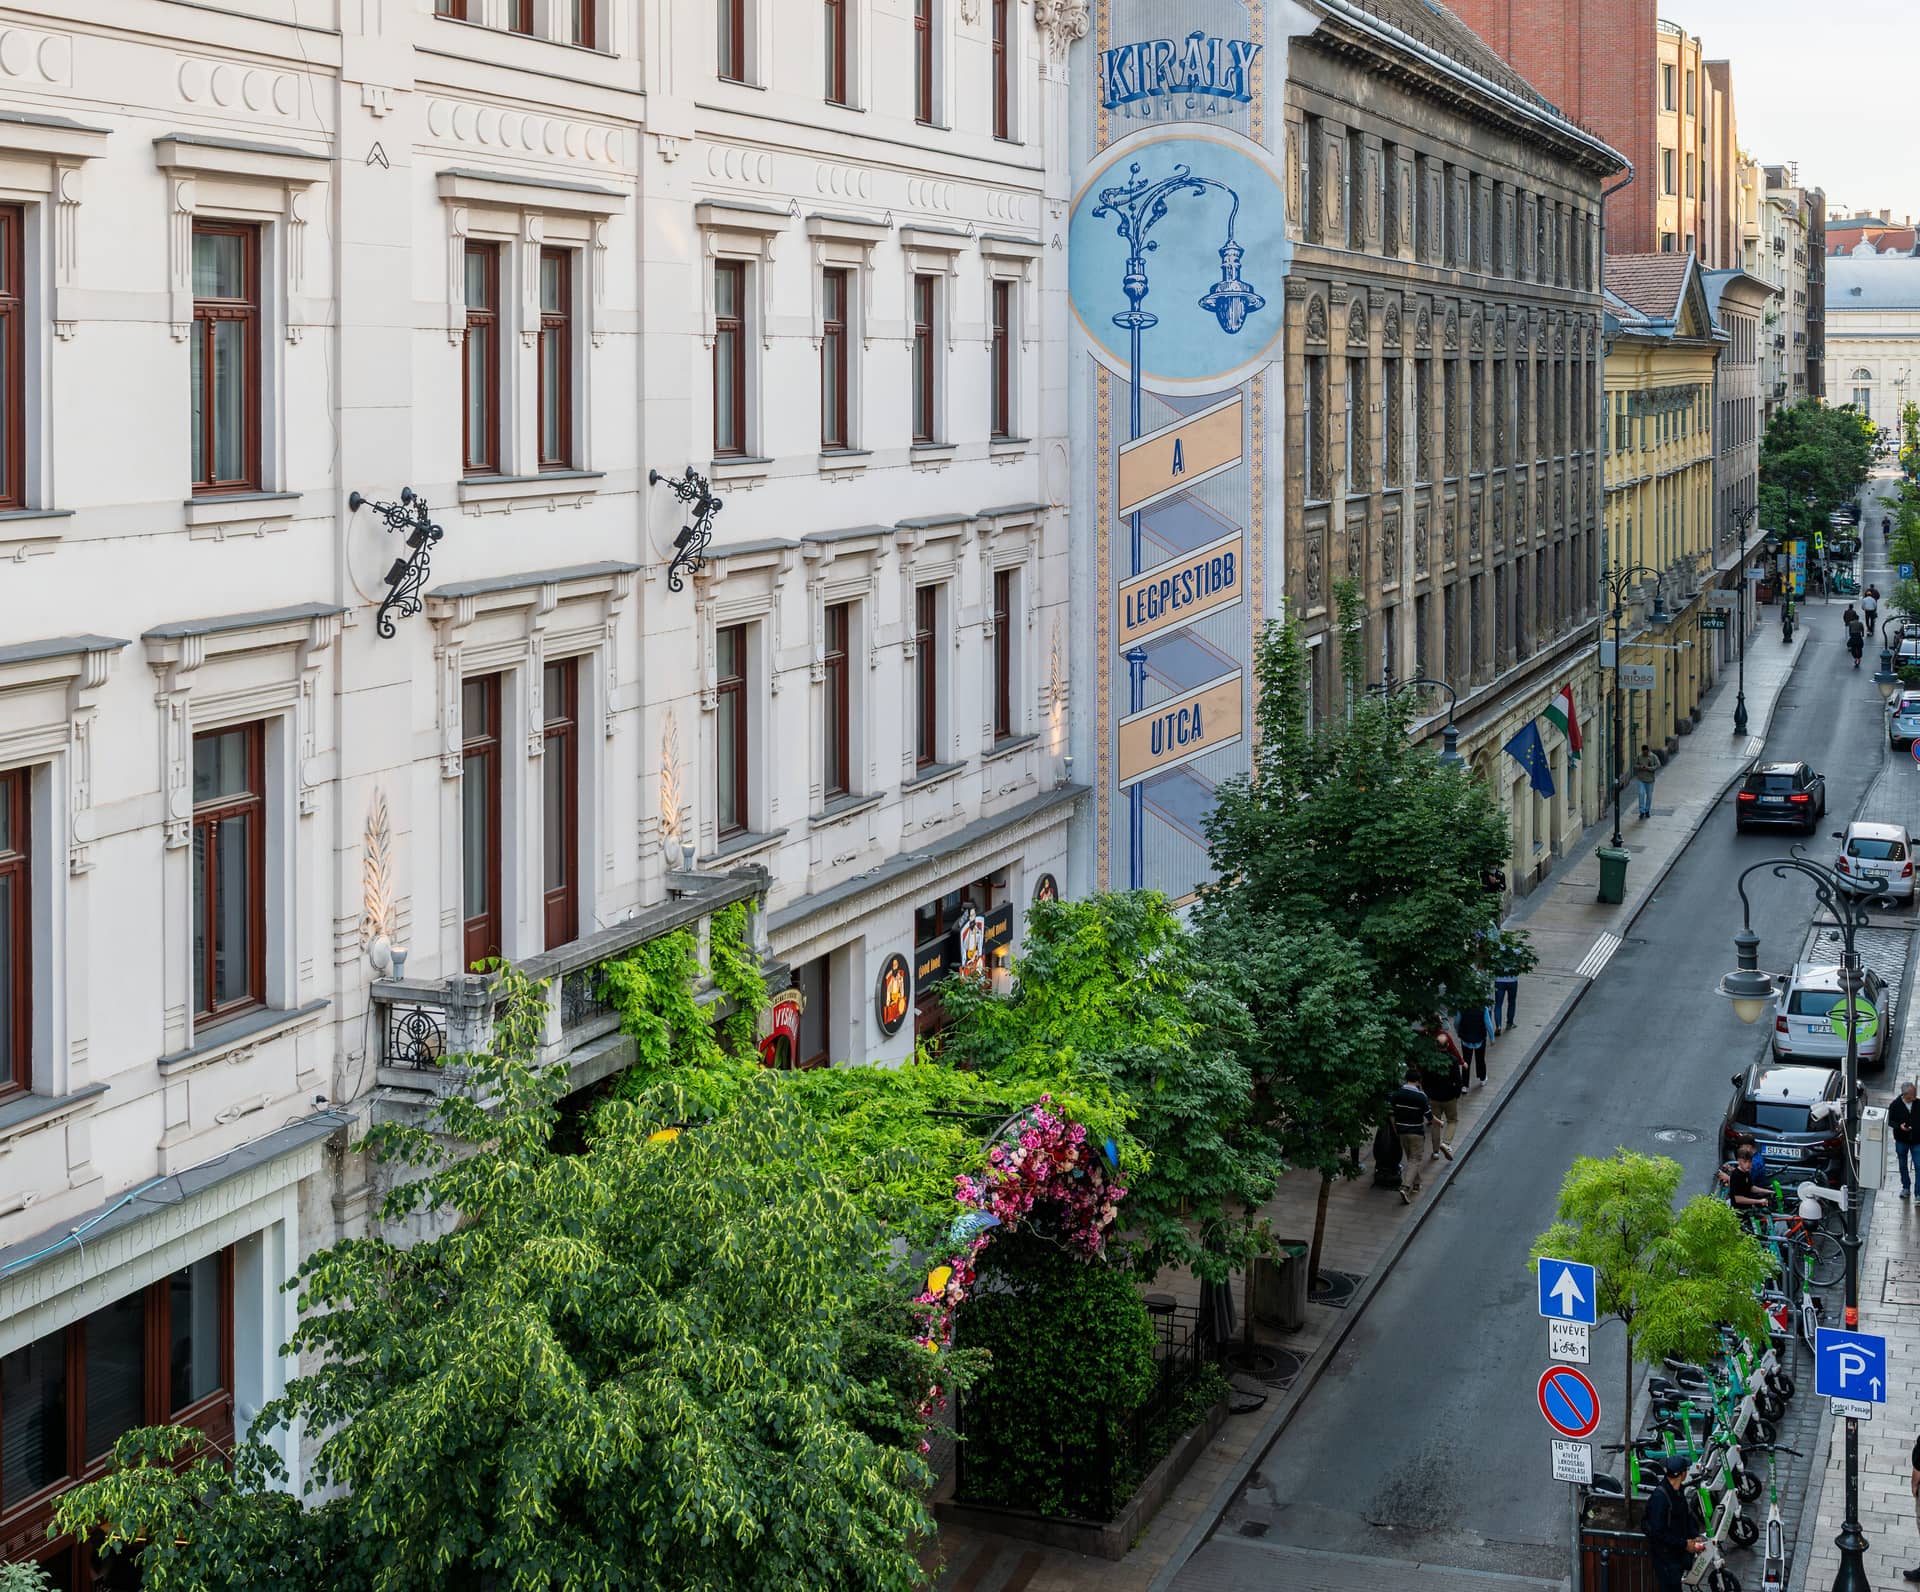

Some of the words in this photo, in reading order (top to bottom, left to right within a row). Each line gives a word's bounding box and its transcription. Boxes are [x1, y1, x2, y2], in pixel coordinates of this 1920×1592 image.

[1100, 31, 1263, 110] KIRÁLY
[1142, 97, 1216, 116] UTCA
[1171, 437, 1185, 477] A
[1126, 552, 1236, 630] LEGPESTIBB
[1151, 703, 1204, 757] UTCA
[1553, 1323, 1586, 1337] KIVÉVE
[1839, 1352, 1866, 1389] P
[1830, 1401, 1850, 1411] Central
